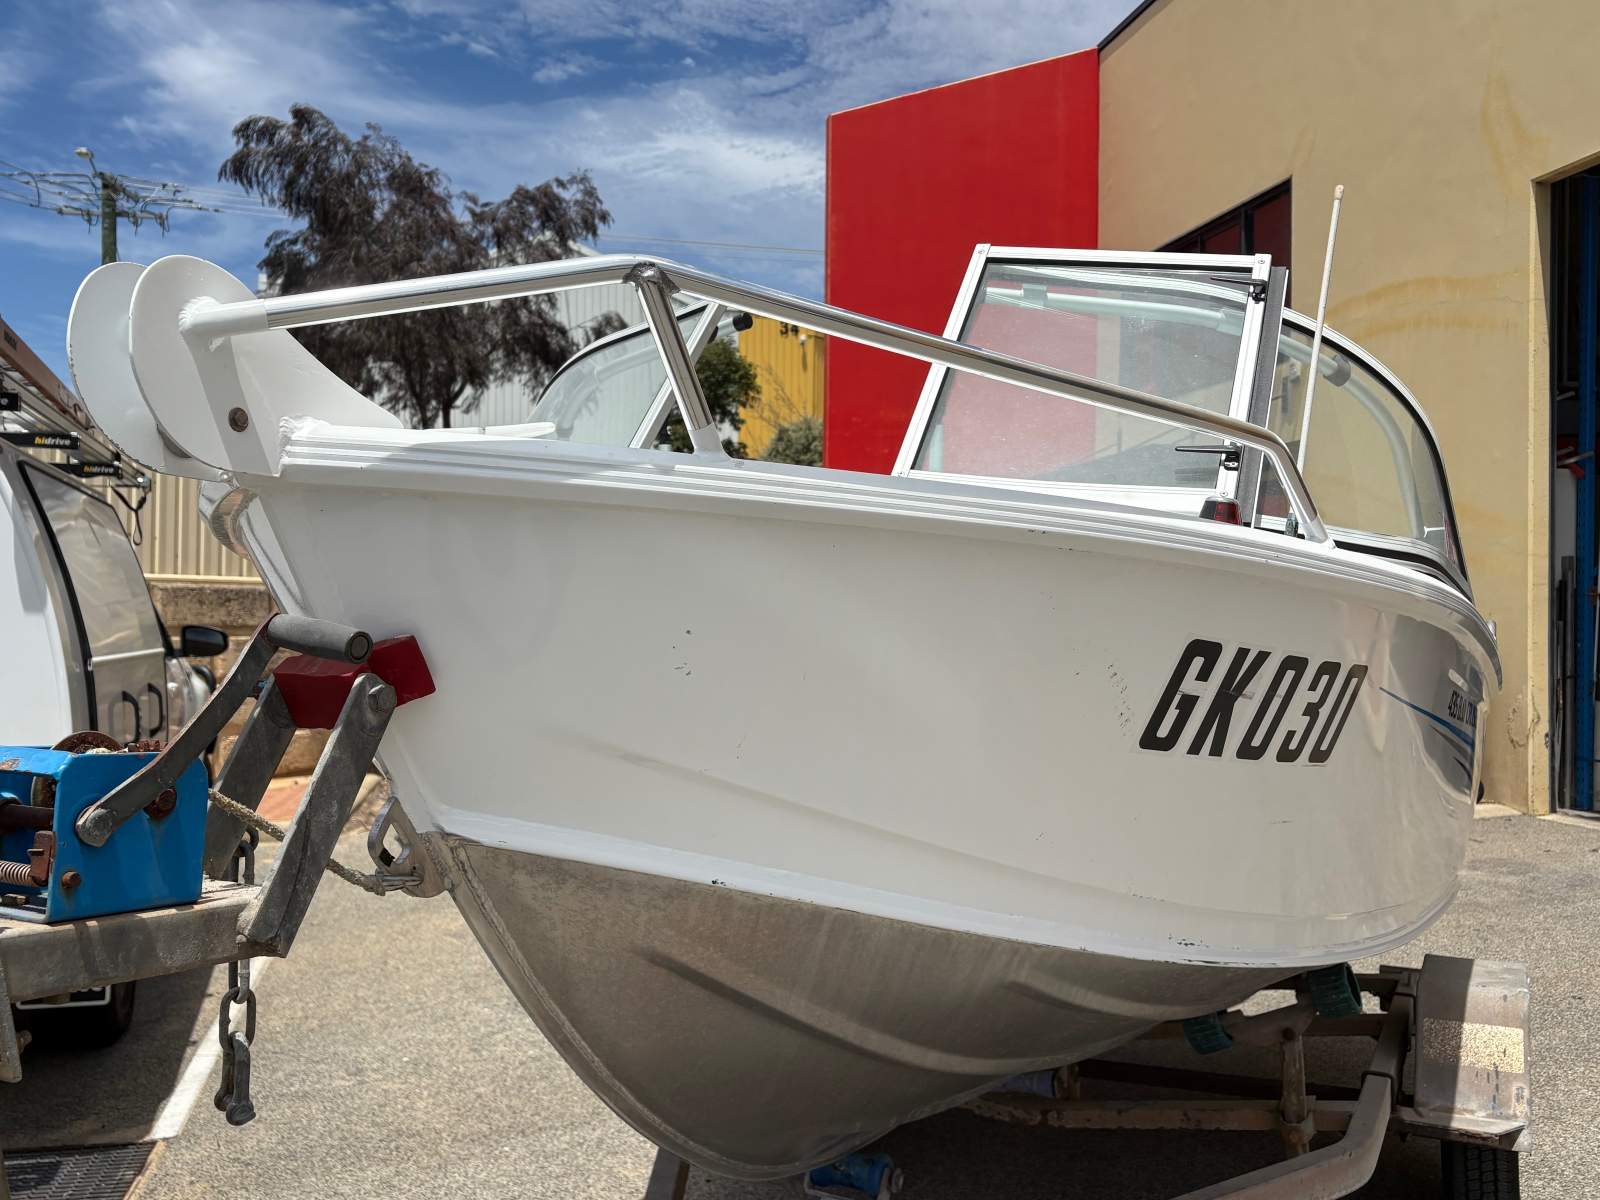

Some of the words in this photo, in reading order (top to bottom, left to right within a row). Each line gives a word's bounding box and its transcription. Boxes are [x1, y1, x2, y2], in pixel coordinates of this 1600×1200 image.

[34, 436, 71, 446] hidrive
[82, 465, 114, 474] hidrive
[1139, 639, 1369, 763] GK030
